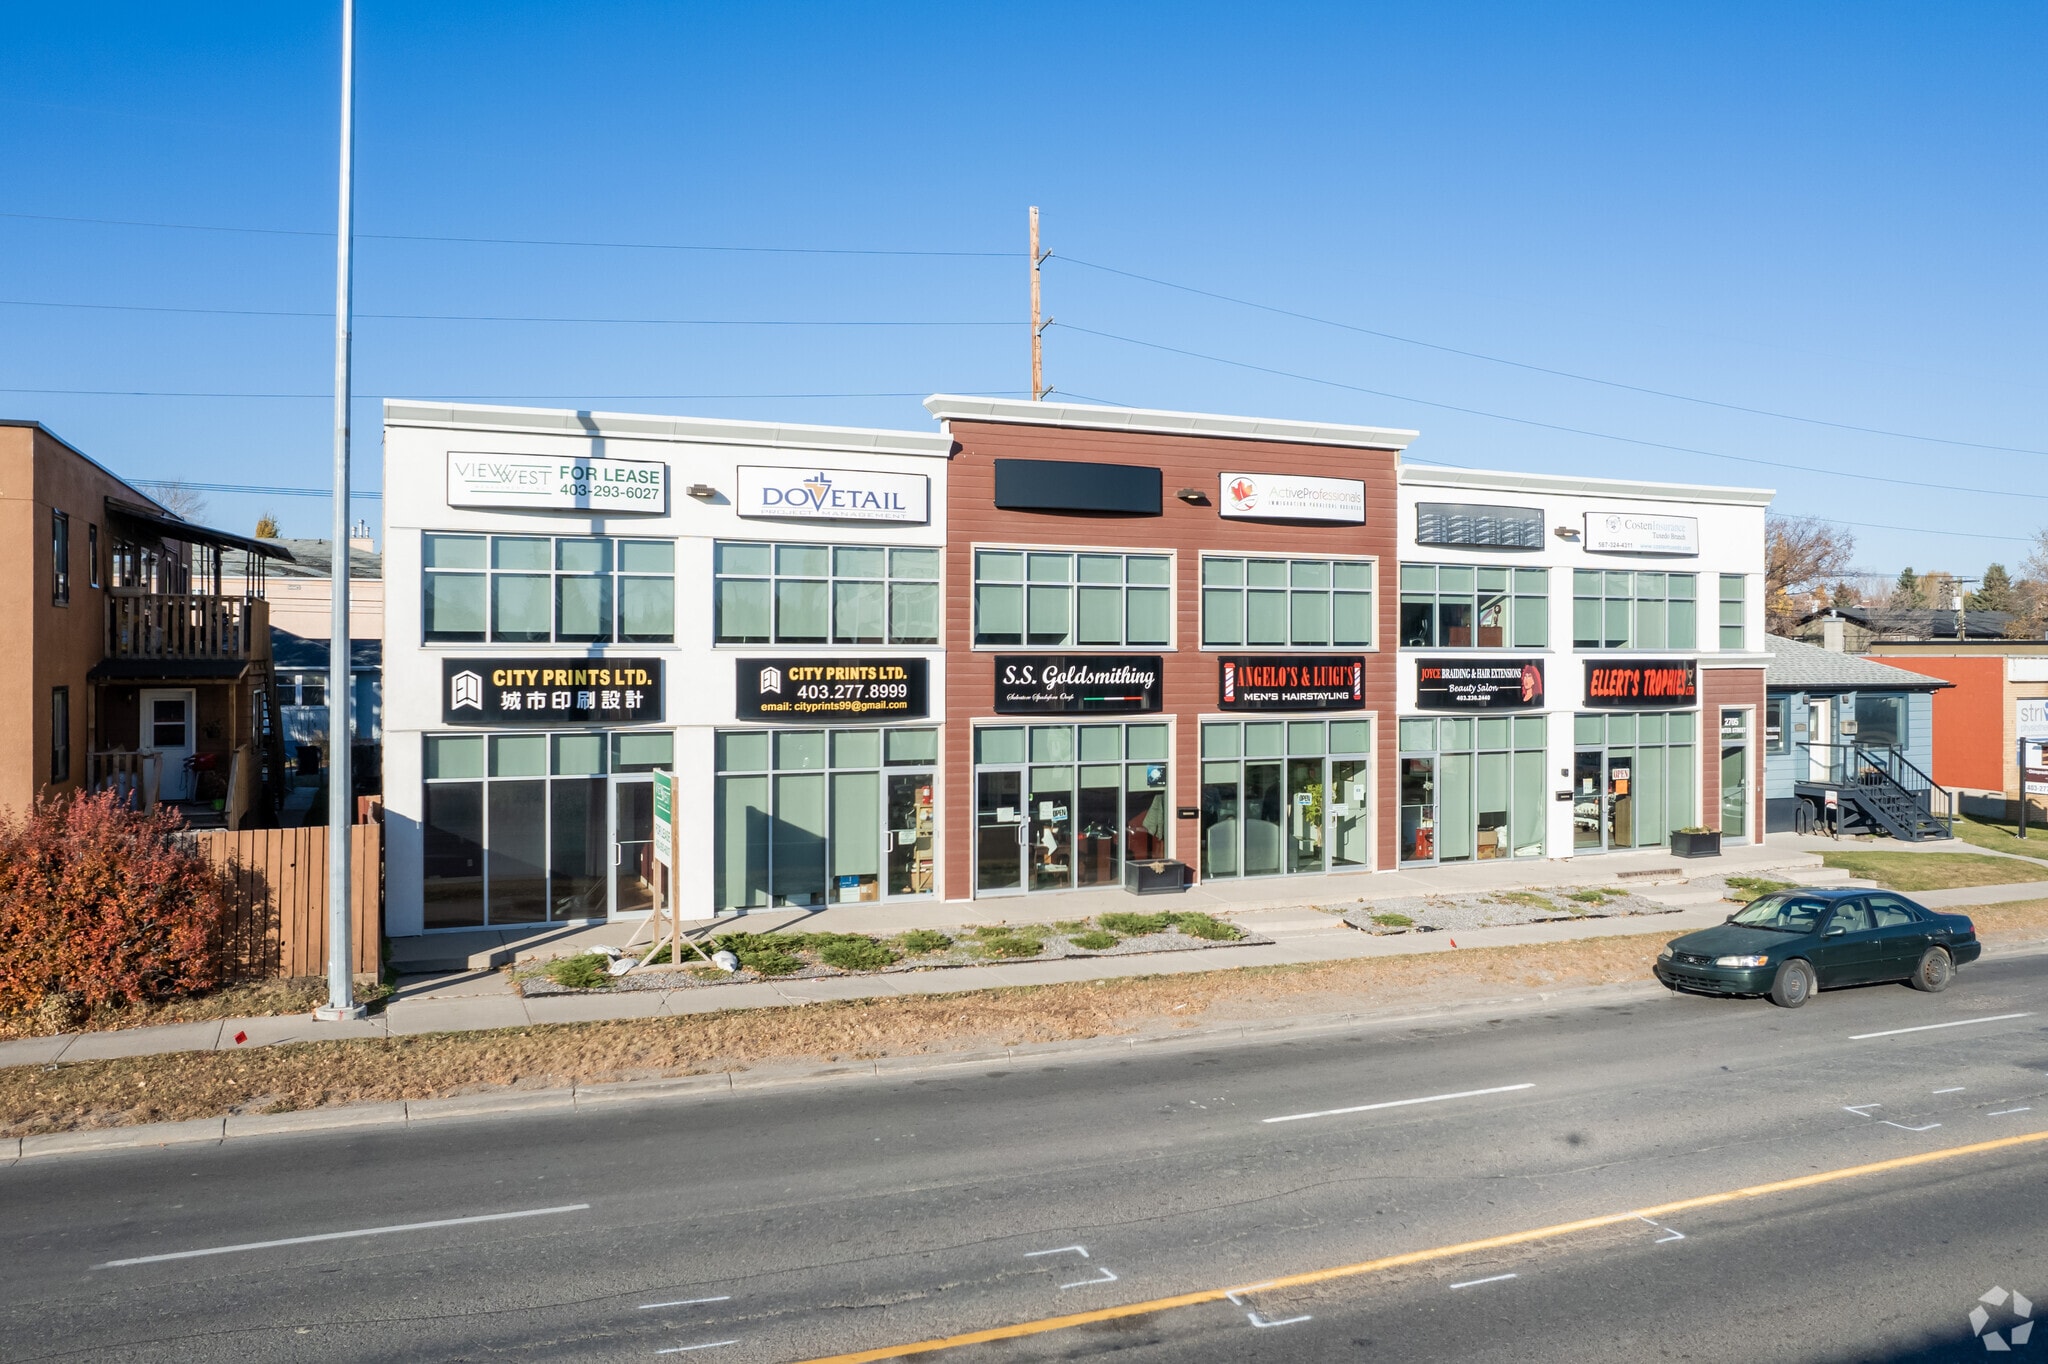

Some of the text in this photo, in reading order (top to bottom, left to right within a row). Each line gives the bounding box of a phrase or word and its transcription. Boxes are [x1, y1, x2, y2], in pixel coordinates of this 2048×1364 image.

[560, 465, 660, 485] FOR LEASE
[560, 483, 660, 500] 403-293-6027
[762, 483, 906, 512] DOVETAIL
[821, 511, 907, 519] MANAGEMENT
[493, 669, 652, 687] CITY PRINTS LTD.
[788, 666, 907, 681] CITY PRINTS LTD.
[1003, 664, 1155, 690] S.S. Goldsmithing
[1237, 665, 1354, 687] ANGELO'S & LUIGI'S
[1421, 667, 1521, 682] JOYCE BRAIDING & HAIR EXTENSIONS
[1449, 683, 1499, 694] Beauty Salon
[1590, 669, 1640, 697] ELLERT'S
[1643, 668, 1686, 696] TROPHIES
[797, 684, 907, 699] 403.277.8999
[1244, 691, 1349, 701] MEN'S HAIRSTAYLING
[501, 690, 644, 710] 城市印刷設計
[760, 701, 907, 712] email: cityprints99@gmail.com
[1614, 769, 1629, 779] OPEN
[1299, 794, 1311, 802] OPEN
[1053, 807, 1066, 817] OPEN
